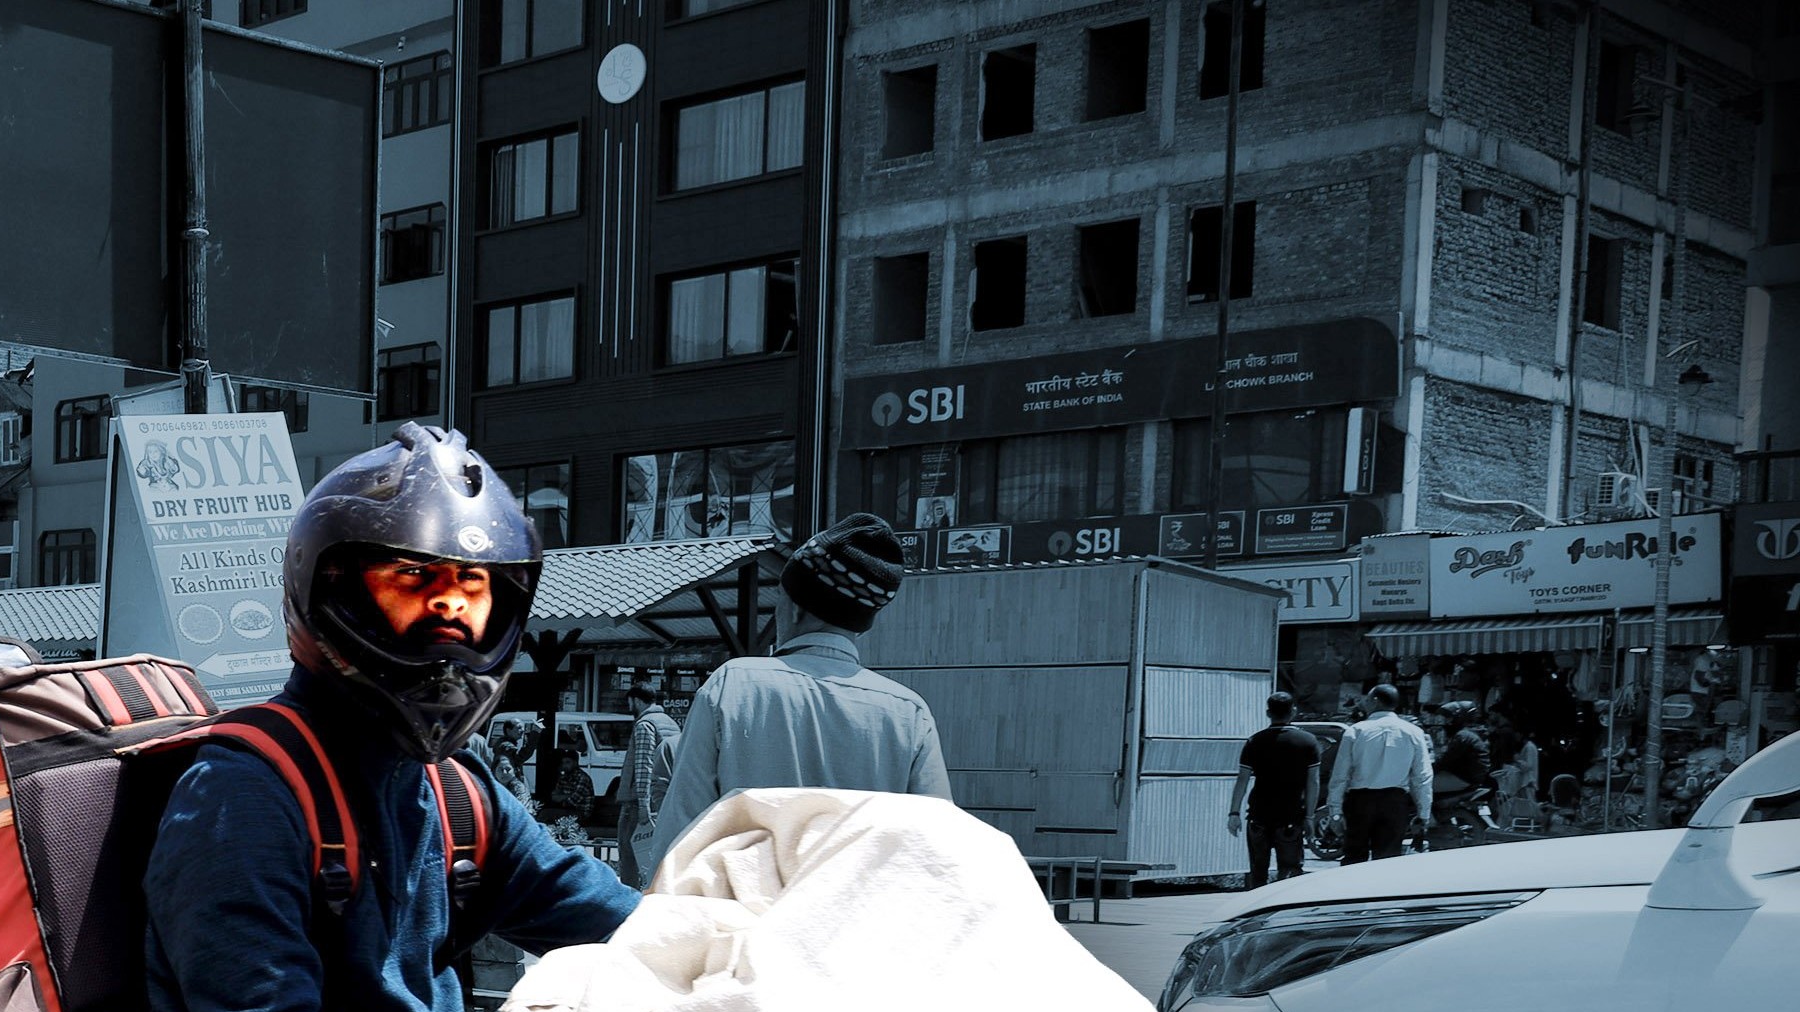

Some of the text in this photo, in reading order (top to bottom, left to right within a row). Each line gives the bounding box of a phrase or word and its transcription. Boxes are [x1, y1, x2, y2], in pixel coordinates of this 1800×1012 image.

[1226, 376, 1266, 389] CHOWK
[1268, 371, 1314, 384] BRANCH
[906, 385, 965, 424] SBI
[1023, 394, 1123, 412] STATE BANK OF INDIA
[176, 433, 292, 489] SIYA
[152, 493, 292, 518] DRY FRUIT HUB
[1276, 513, 1295, 525] SBI
[152, 518, 296, 541] We Are Dealing Wit
[902, 536, 918, 547] SBI
[1075, 527, 1121, 554] SBI
[180, 546, 287, 571] All Kinds O
[1365, 560, 1424, 576] BEAUTIES
[170, 570, 285, 595] Kashmiri Ite
[1529, 583, 1612, 597] TOYS CORNER
[663, 699, 689, 708] CASIO
